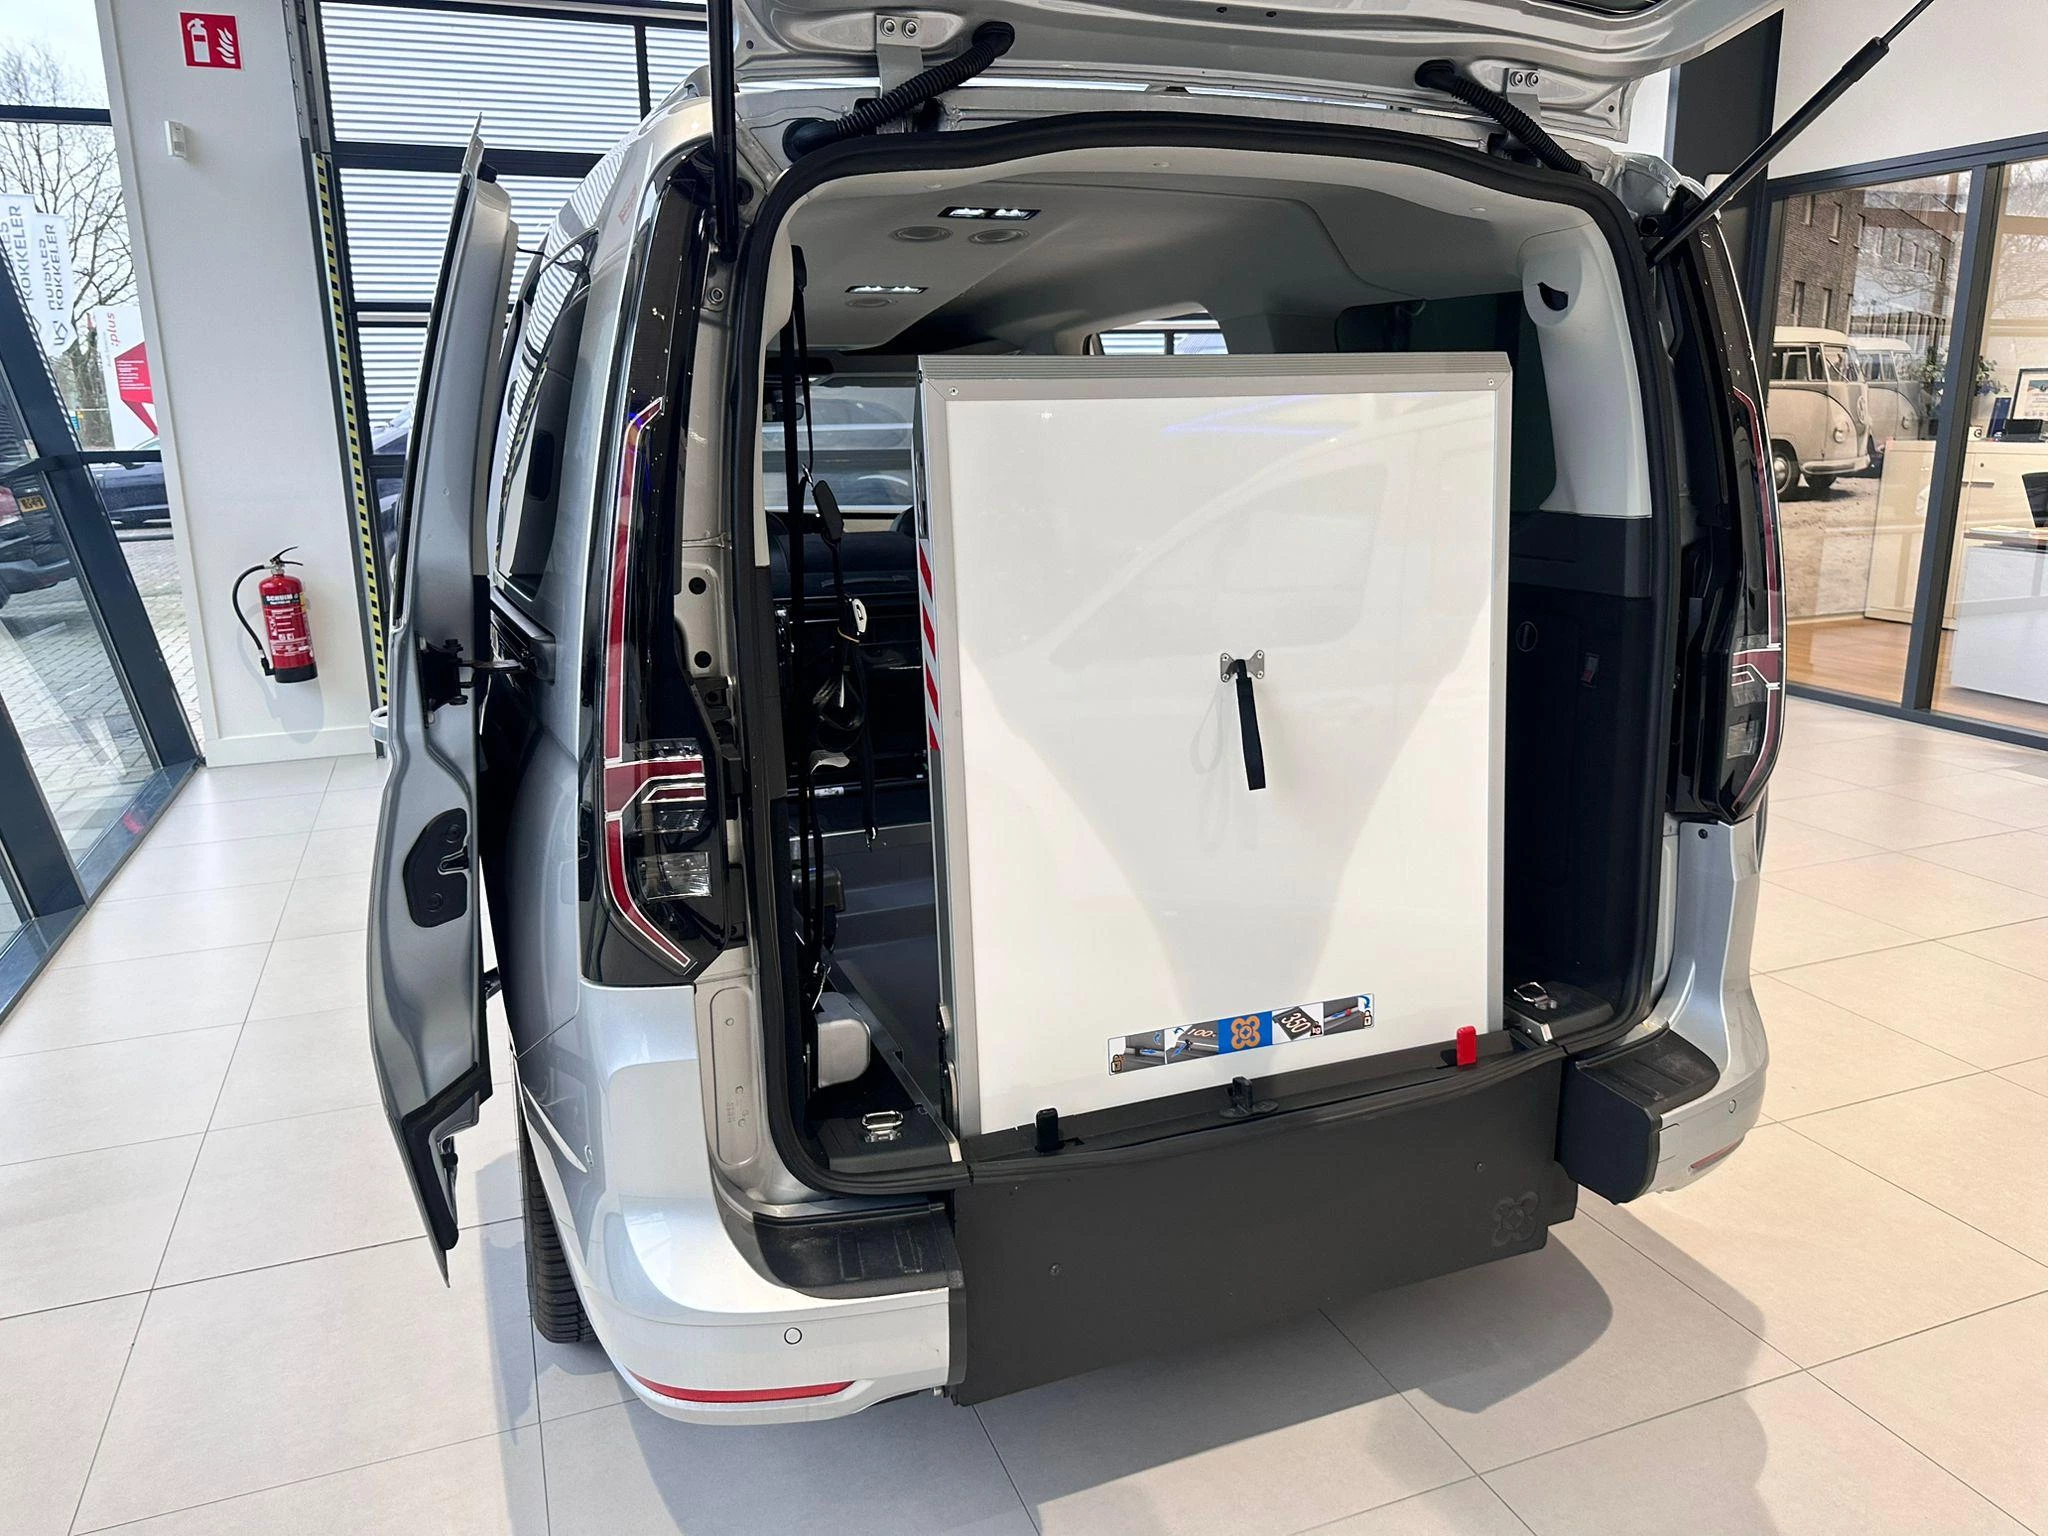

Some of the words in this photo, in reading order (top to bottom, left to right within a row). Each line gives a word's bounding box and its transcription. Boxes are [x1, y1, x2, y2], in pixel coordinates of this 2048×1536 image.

[9, 205, 34, 301] KOKKELER
[44, 224, 64, 310] KOKKELER
[1281, 1012, 1311, 1033] 350
